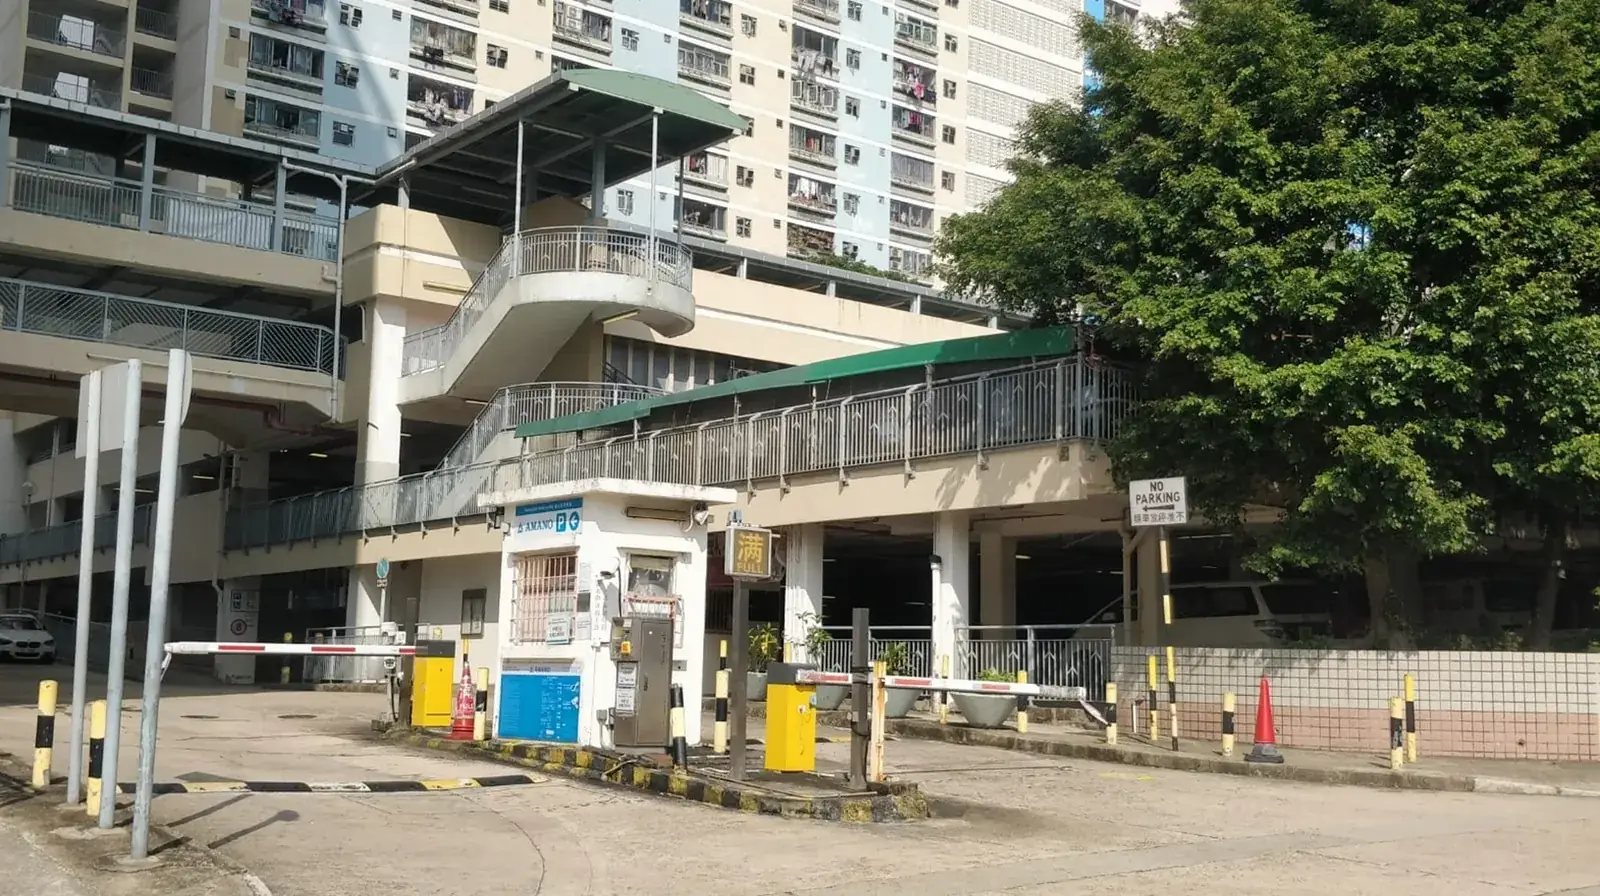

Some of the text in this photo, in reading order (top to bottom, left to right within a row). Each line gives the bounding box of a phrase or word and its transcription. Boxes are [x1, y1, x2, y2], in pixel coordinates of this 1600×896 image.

[1150, 481, 1164, 492] NO
[1135, 491, 1180, 504] PARKING
[525, 519, 553, 531] AMANO
[737, 562, 763, 573] FULL
